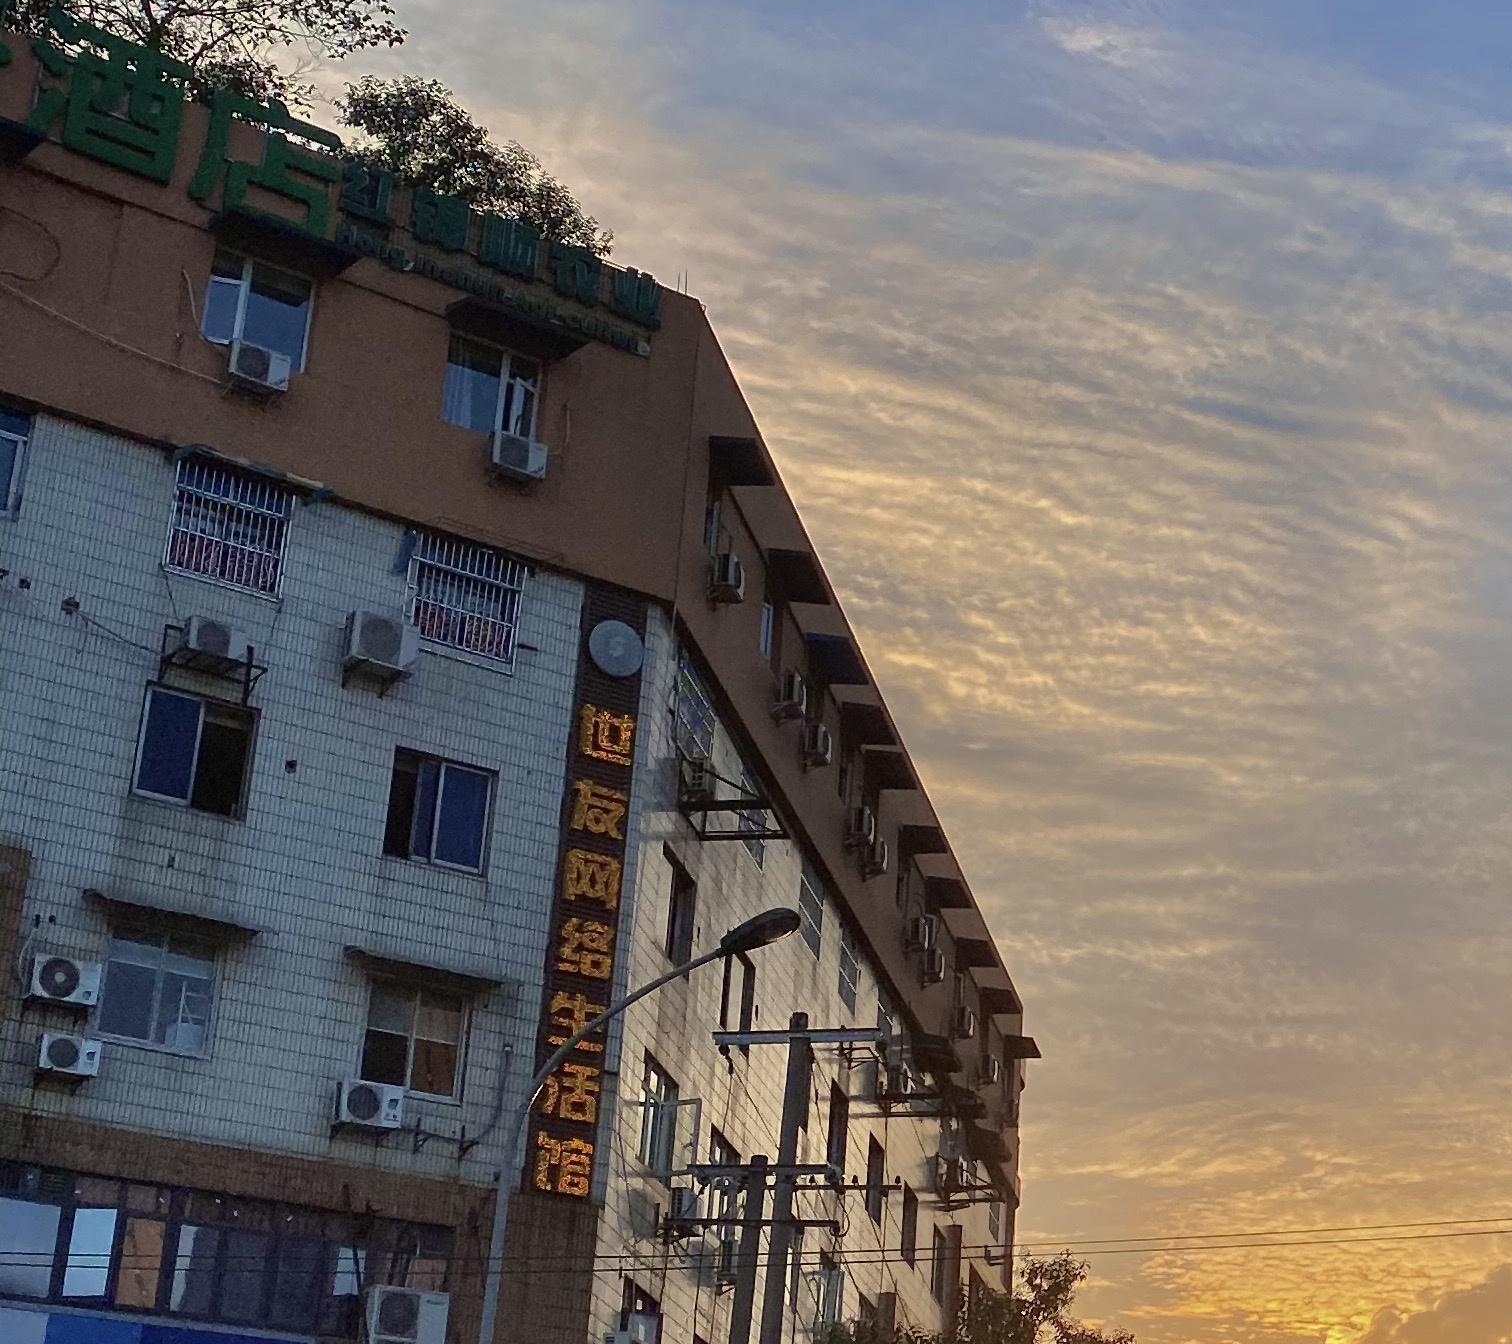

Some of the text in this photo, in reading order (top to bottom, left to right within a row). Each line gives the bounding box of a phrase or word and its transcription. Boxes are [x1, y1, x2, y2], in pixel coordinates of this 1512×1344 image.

[536, 703, 636, 1197] 世友网络生活馆
